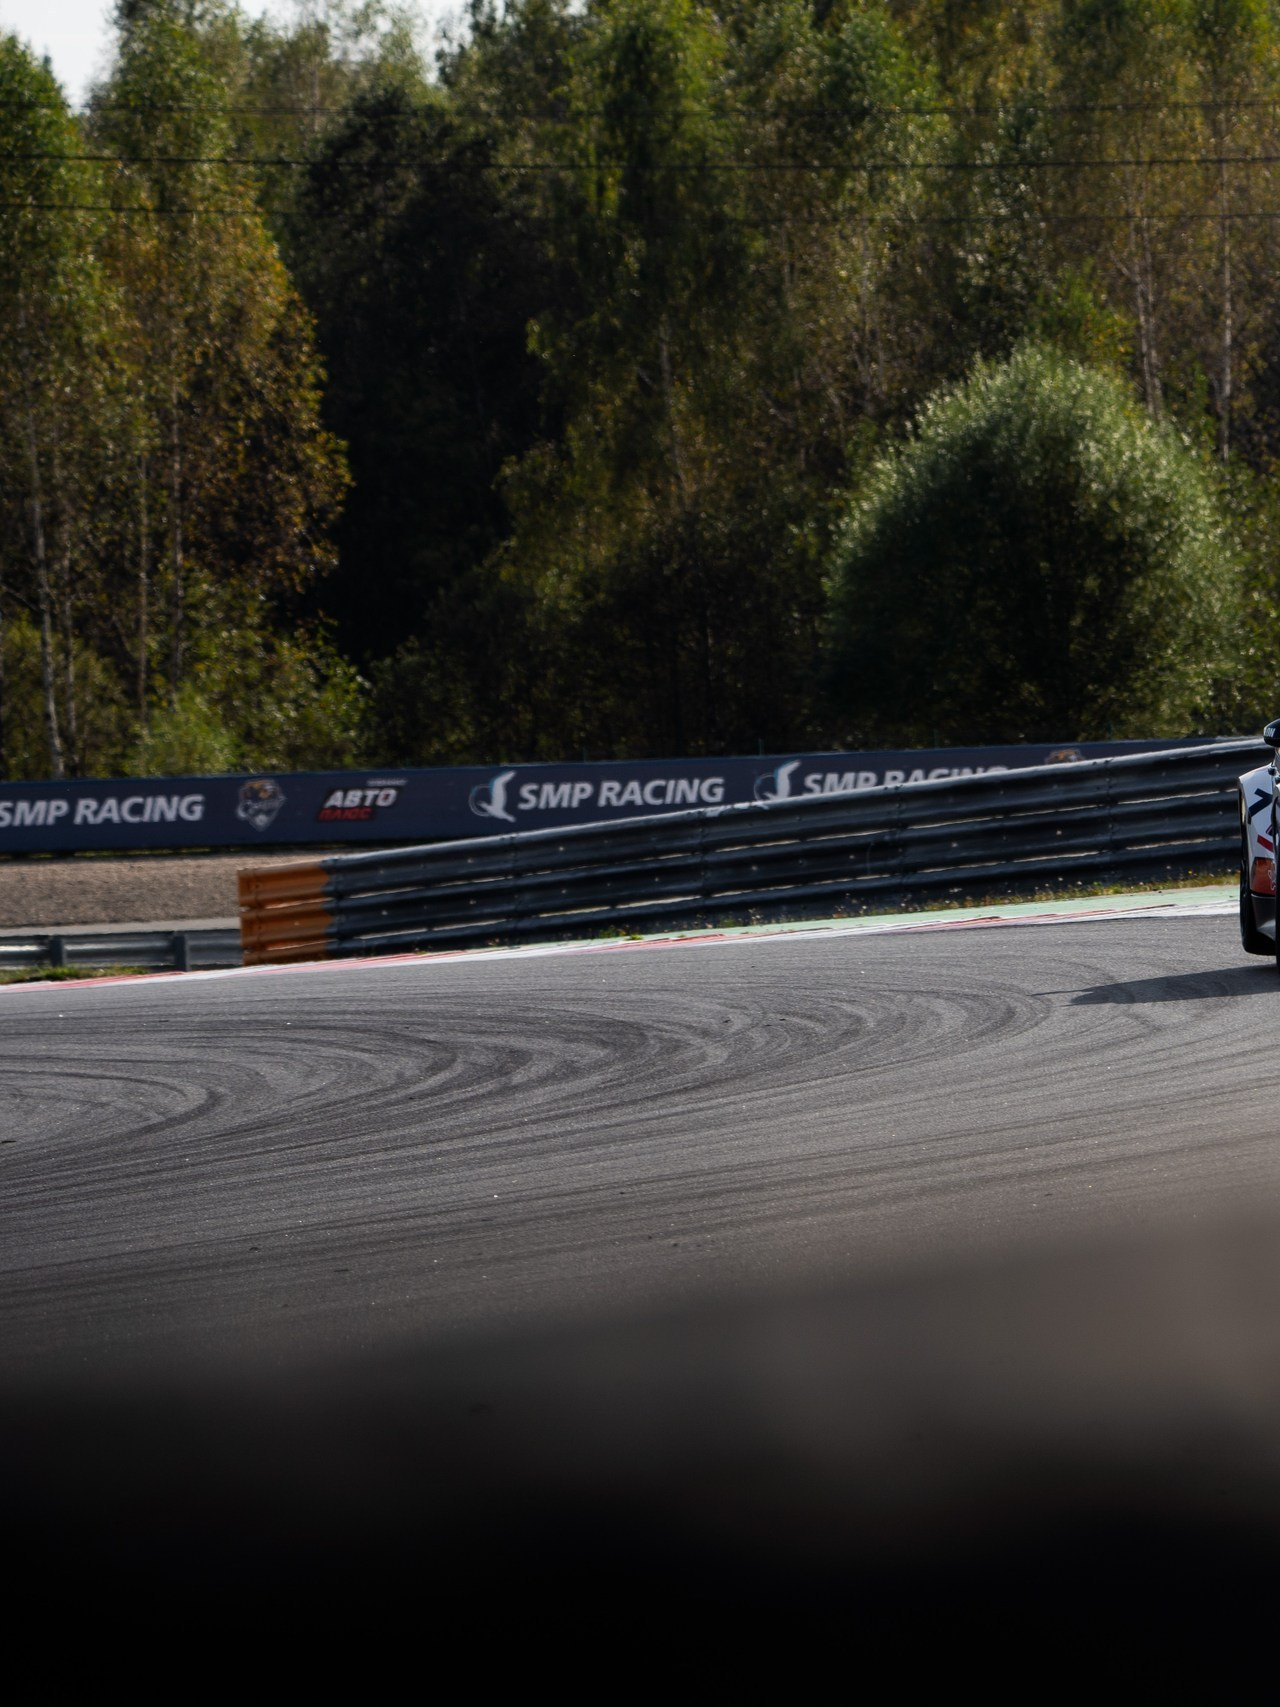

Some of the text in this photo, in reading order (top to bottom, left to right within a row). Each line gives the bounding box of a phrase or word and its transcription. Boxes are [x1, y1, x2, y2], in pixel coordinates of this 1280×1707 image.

[323, 787, 398, 809] АВТО
[517, 776, 725, 810] SMP RACING
[0, 799, 69, 828] SMP
[73, 794, 205, 825] RACING
